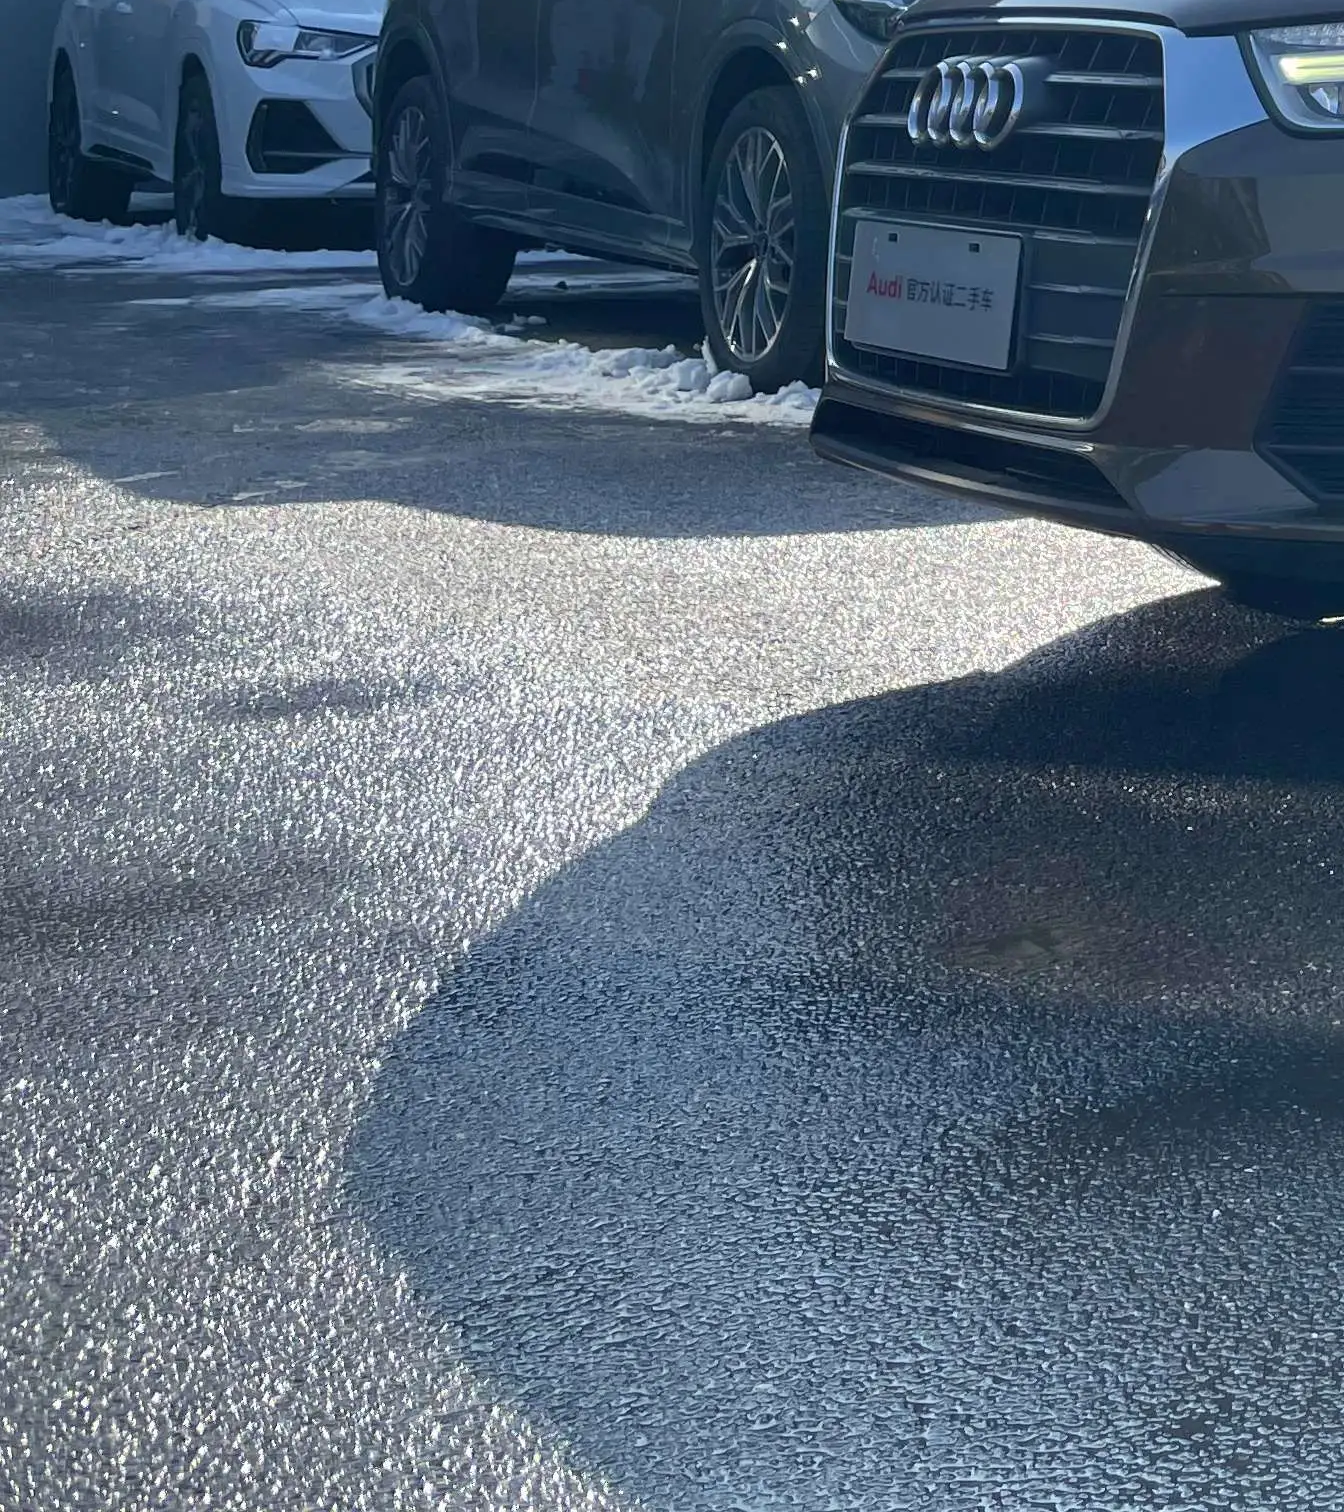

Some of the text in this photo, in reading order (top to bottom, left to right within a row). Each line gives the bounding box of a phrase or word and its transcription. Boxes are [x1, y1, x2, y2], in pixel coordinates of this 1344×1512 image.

[866, 270, 994, 313] Audi 官方认证二手车
